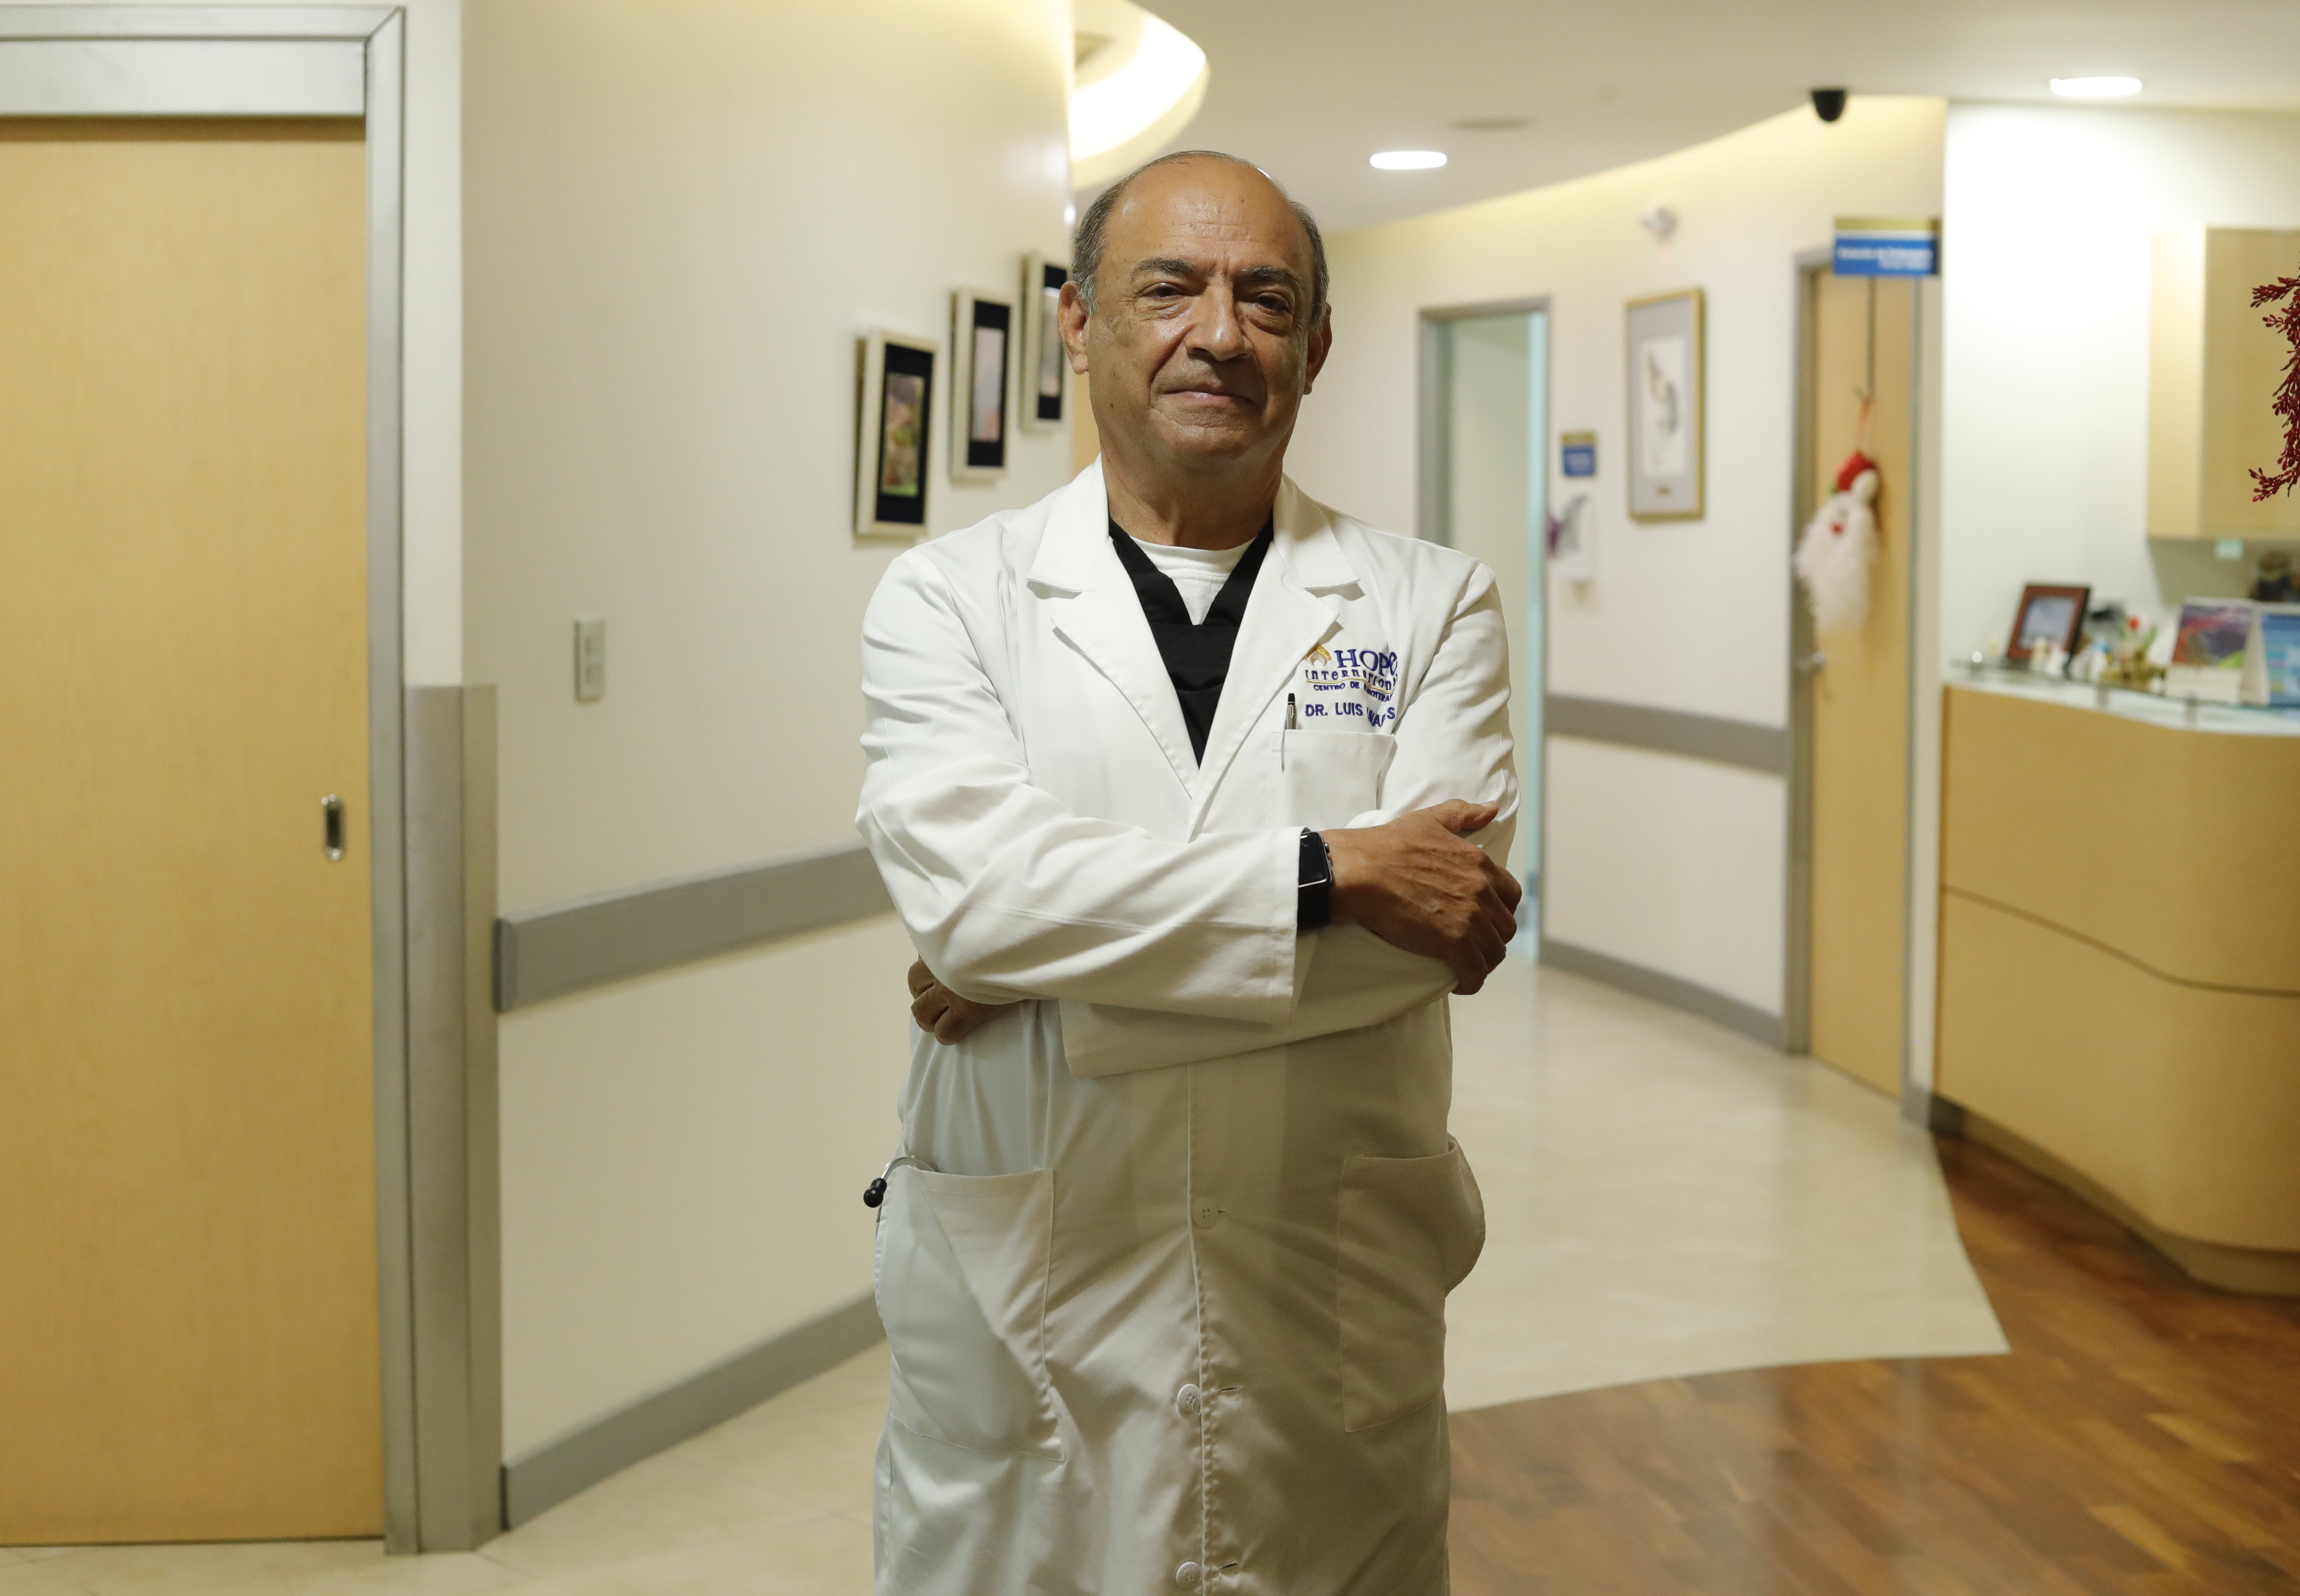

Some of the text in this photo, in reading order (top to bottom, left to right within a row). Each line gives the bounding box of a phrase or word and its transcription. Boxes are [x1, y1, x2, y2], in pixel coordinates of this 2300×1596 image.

[1313, 683, 1345, 691] CENTRO
[1304, 703, 1328, 716] DR.
[1335, 702, 1363, 716] LUIS
